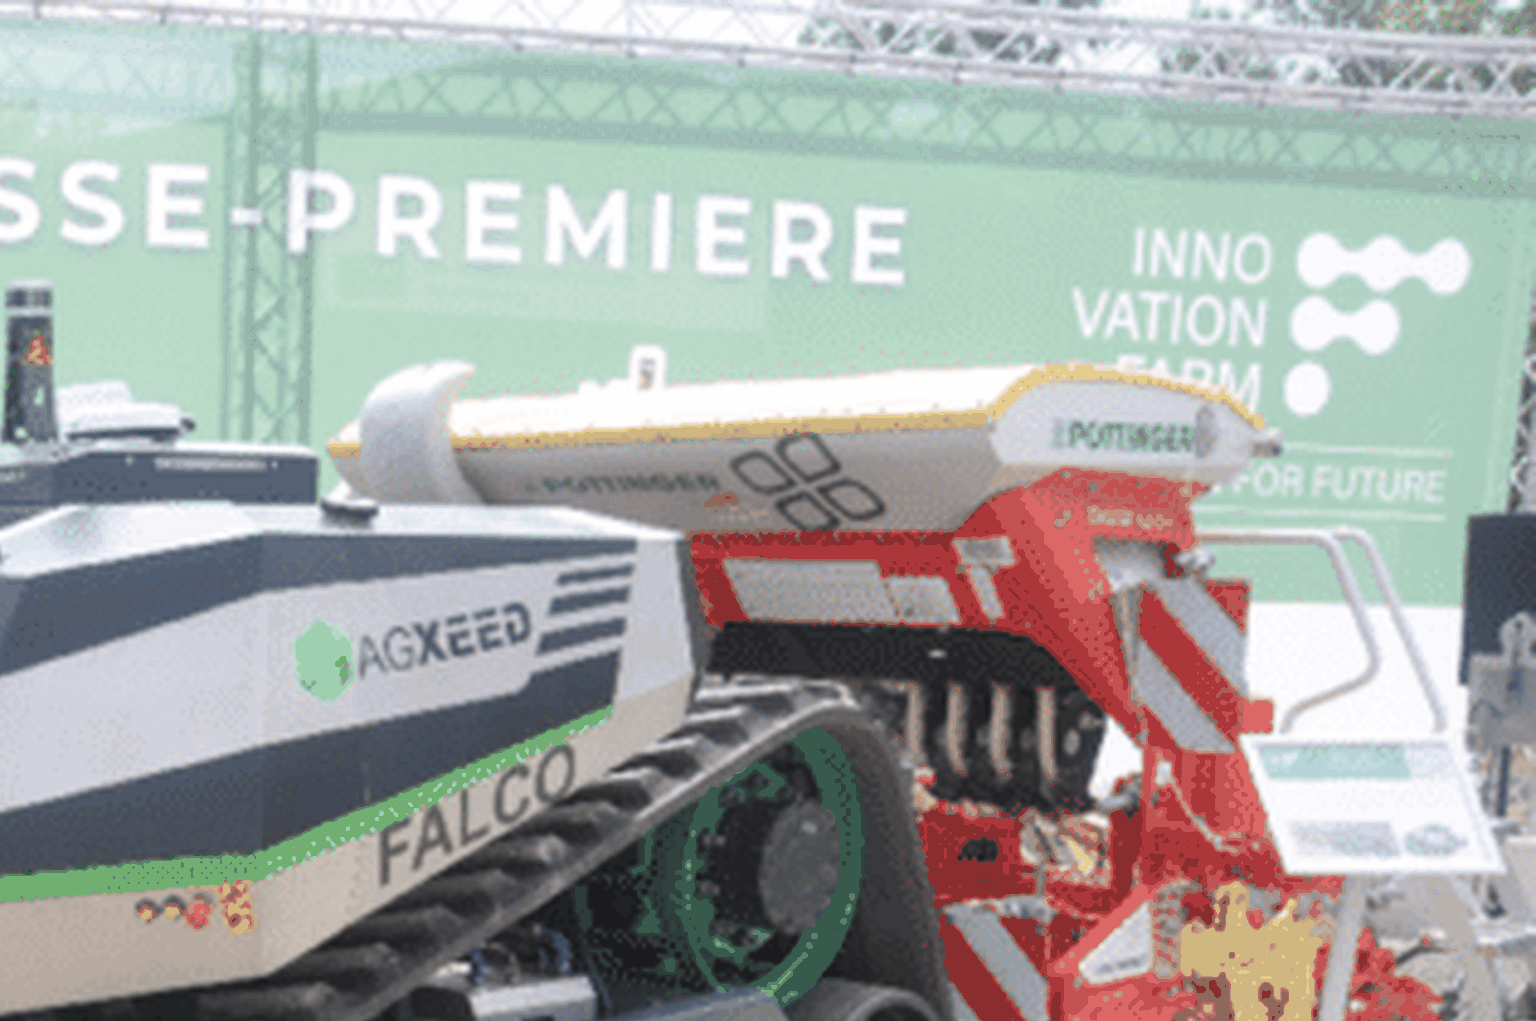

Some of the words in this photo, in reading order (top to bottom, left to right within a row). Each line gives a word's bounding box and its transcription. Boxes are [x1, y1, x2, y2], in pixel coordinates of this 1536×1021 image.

[1132, 227, 1272, 284] INNO
[1072, 287, 1268, 347] VATION
[1312, 464, 1446, 503] FUTURE
[357, 601, 534, 680] AGXEED
[379, 743, 575, 886] FALCO
